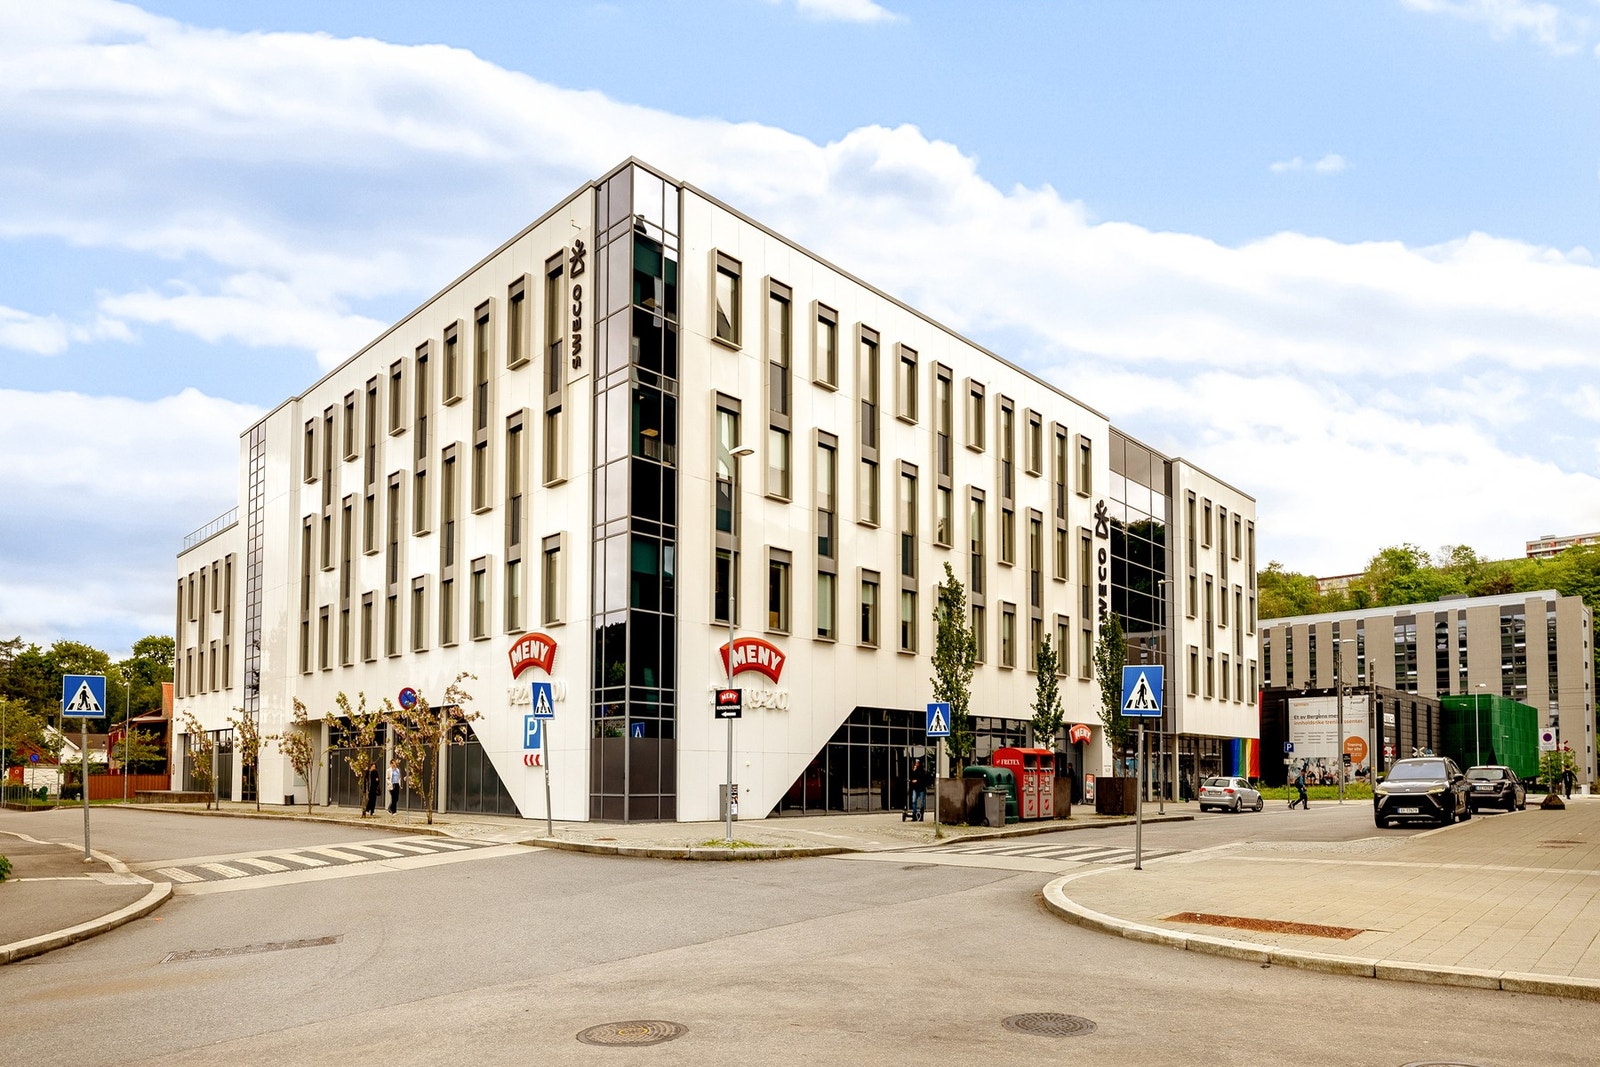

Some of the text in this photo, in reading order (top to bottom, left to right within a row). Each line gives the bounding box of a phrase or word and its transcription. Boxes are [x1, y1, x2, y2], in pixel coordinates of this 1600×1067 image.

[572, 284, 582, 370] SWECO
[511, 640, 549, 668] MENY
[732, 644, 782, 671] MENY
[721, 692, 737, 701] MENY
[526, 717, 538, 747] P
